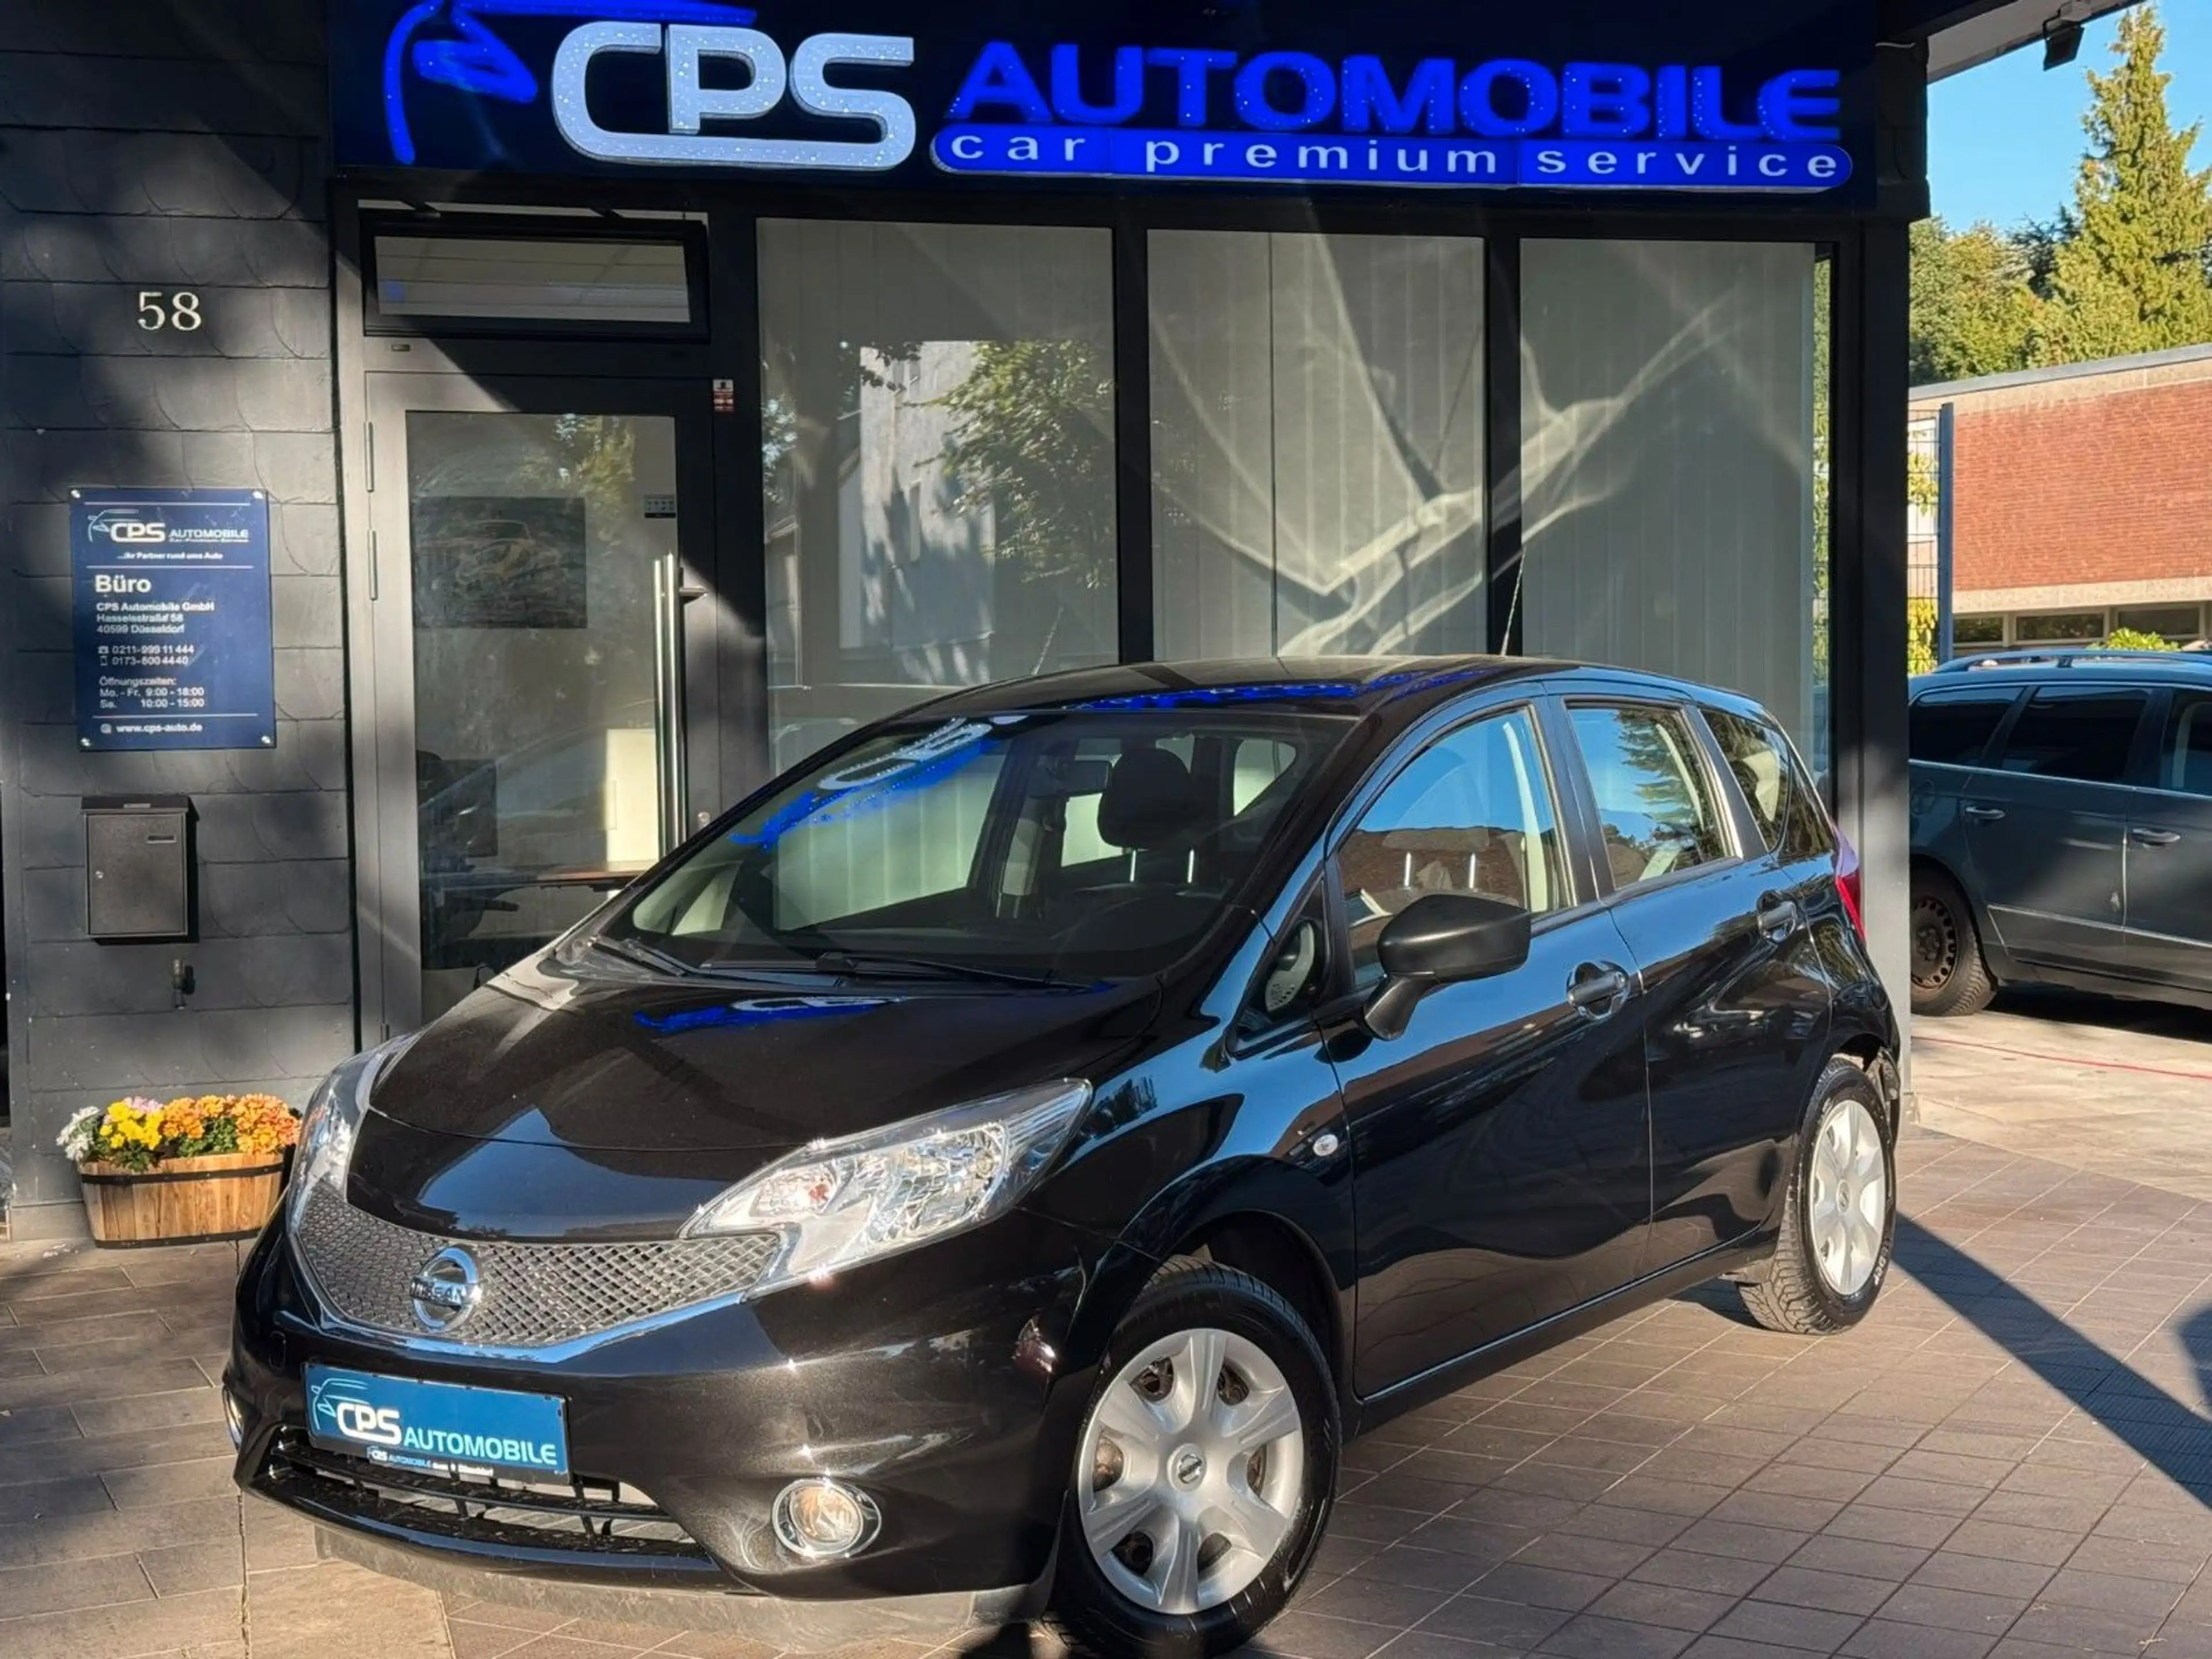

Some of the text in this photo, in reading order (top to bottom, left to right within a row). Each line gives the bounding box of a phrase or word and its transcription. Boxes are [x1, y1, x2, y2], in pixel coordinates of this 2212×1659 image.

[551, 21, 1840, 171] CPS AUTOMOBILE
[950, 134, 1838, 178] car premium service
[138, 291, 202, 331] 58
[111, 522, 249, 543] CPS AUTOMOBILE
[95, 574, 151, 593] Büro
[96, 601, 214, 611] CPS Automobile GmbH
[170, 613, 184, 623] 58
[97, 624, 184, 634] 40599 Düsseldorf
[145, 687, 168, 696] 9:00
[177, 687, 204, 696] 18:00
[141, 698, 168, 708] 10:00
[177, 698, 204, 707] 15:00
[337, 1402, 558, 1465] CPS AUTOMOBILE
